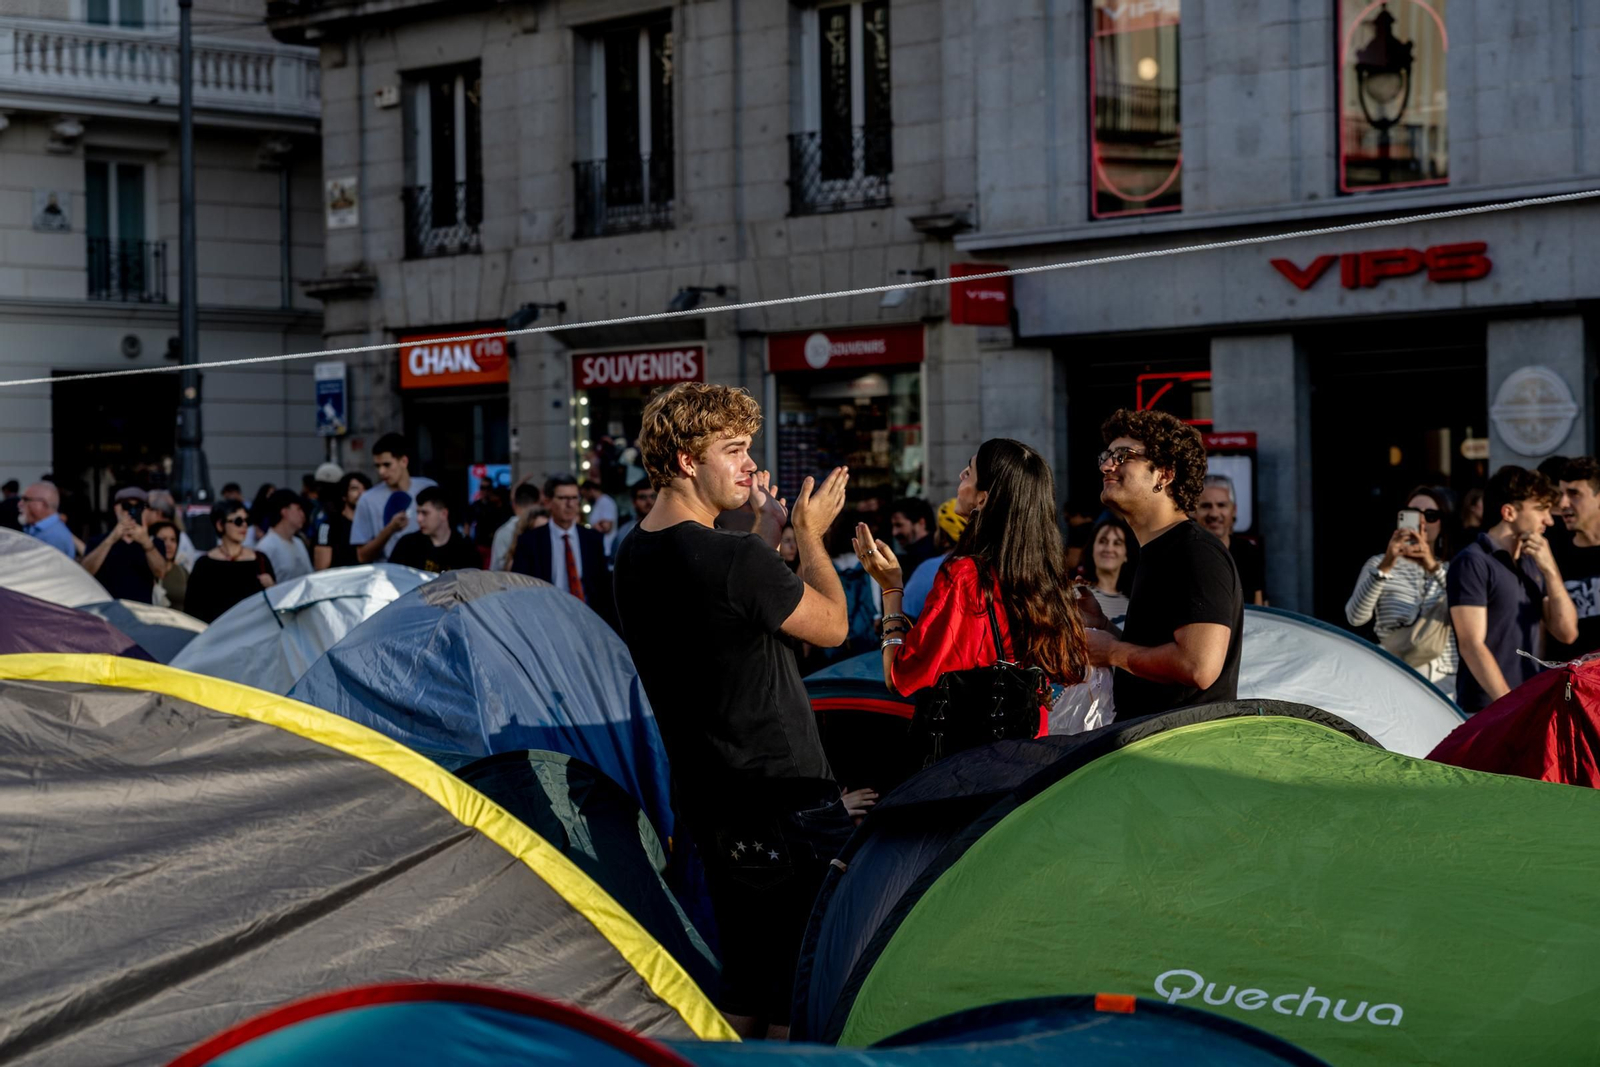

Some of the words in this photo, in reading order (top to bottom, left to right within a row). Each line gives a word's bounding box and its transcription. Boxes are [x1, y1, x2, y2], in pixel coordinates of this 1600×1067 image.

[1269, 240, 1493, 291] VIPS
[965, 289, 1006, 302] VIPS
[829, 339, 887, 357] SOUVENIRS
[582, 350, 698, 385] SOUVENIRS
[1153, 968, 1404, 1027] Quechua
